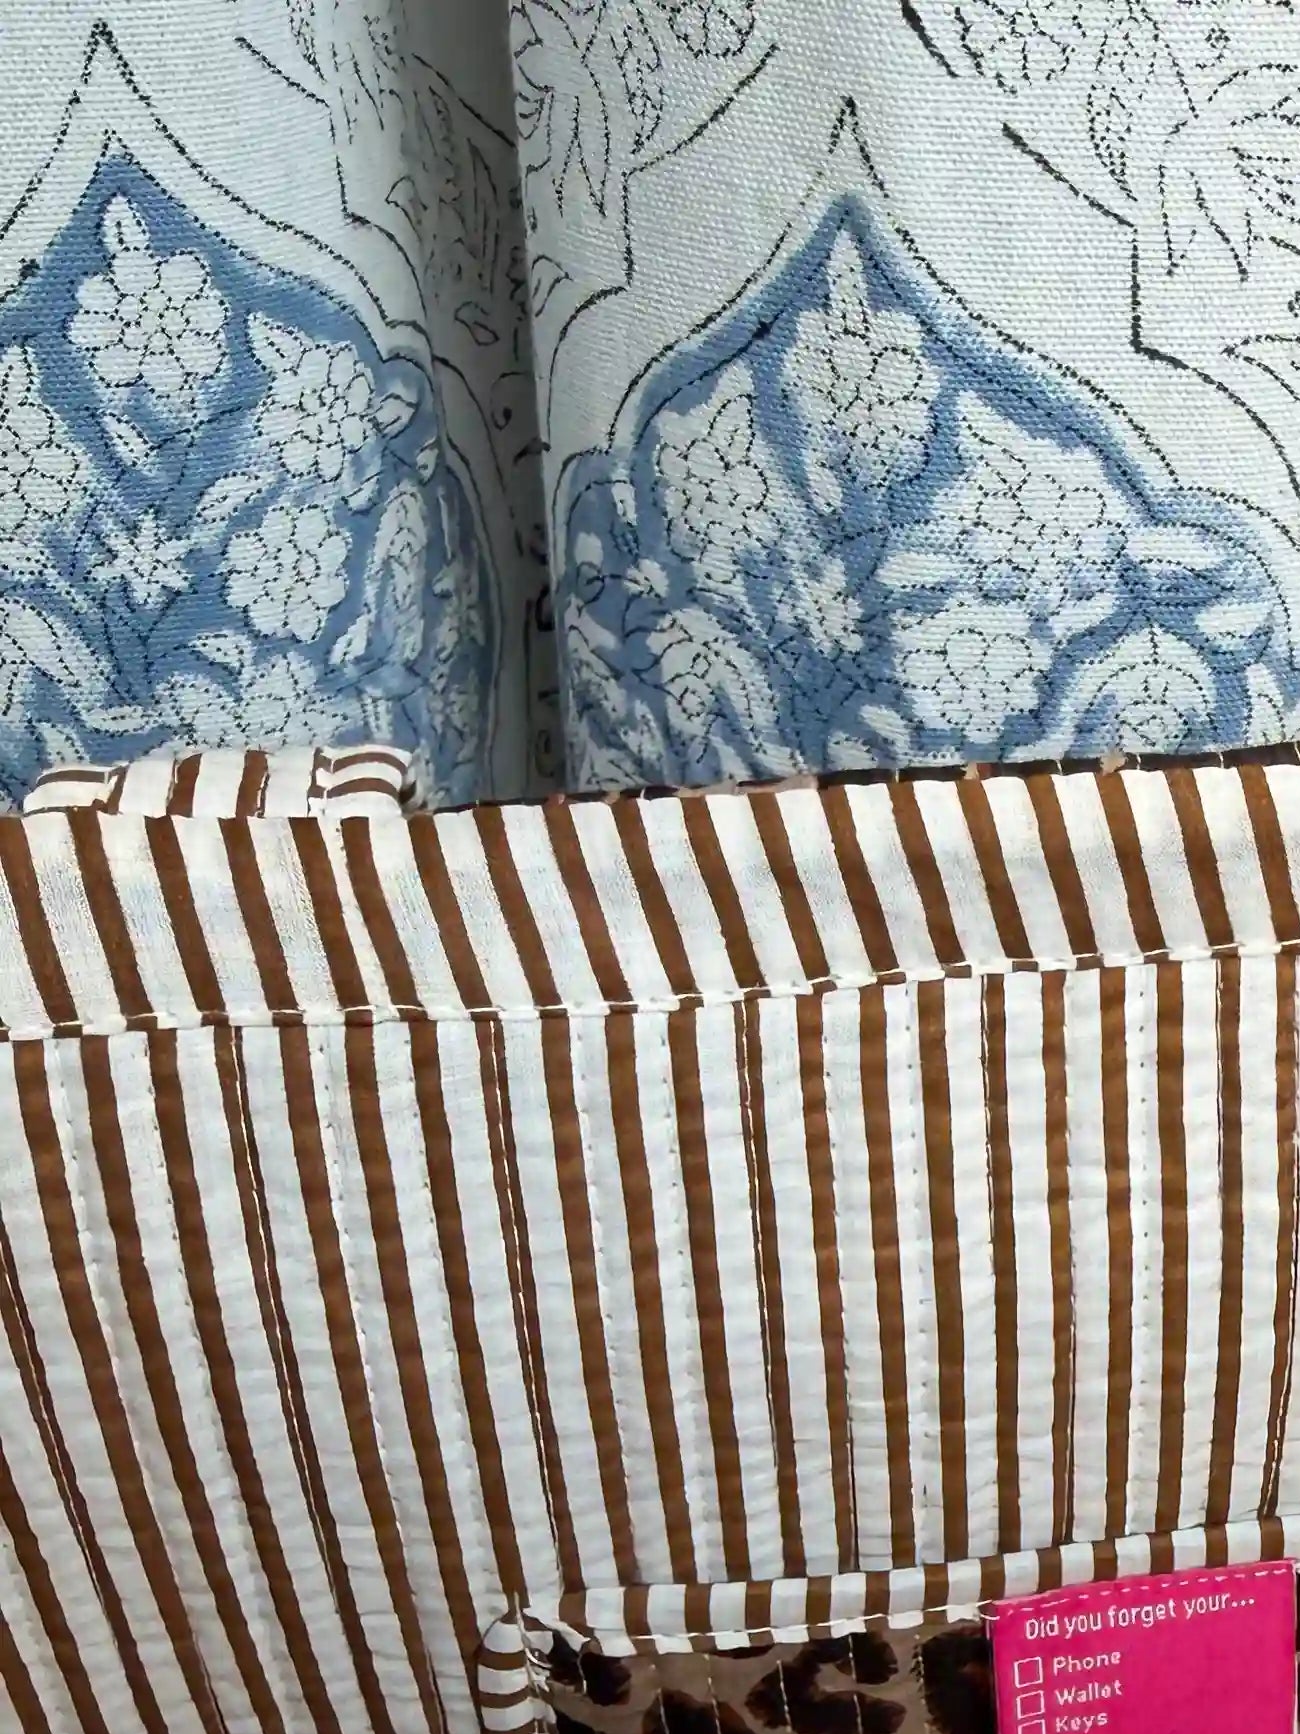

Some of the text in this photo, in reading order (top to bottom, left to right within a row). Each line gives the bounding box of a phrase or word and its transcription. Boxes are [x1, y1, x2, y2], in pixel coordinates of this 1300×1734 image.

[1025, 1616, 1059, 1639] Did
[1064, 1613, 1101, 1639] you
[1108, 1598, 1177, 1628] forget
[1053, 1650, 1121, 1674] Phone
[1055, 1679, 1123, 1705] Wallet
[1055, 1712, 1108, 1733] Keys
